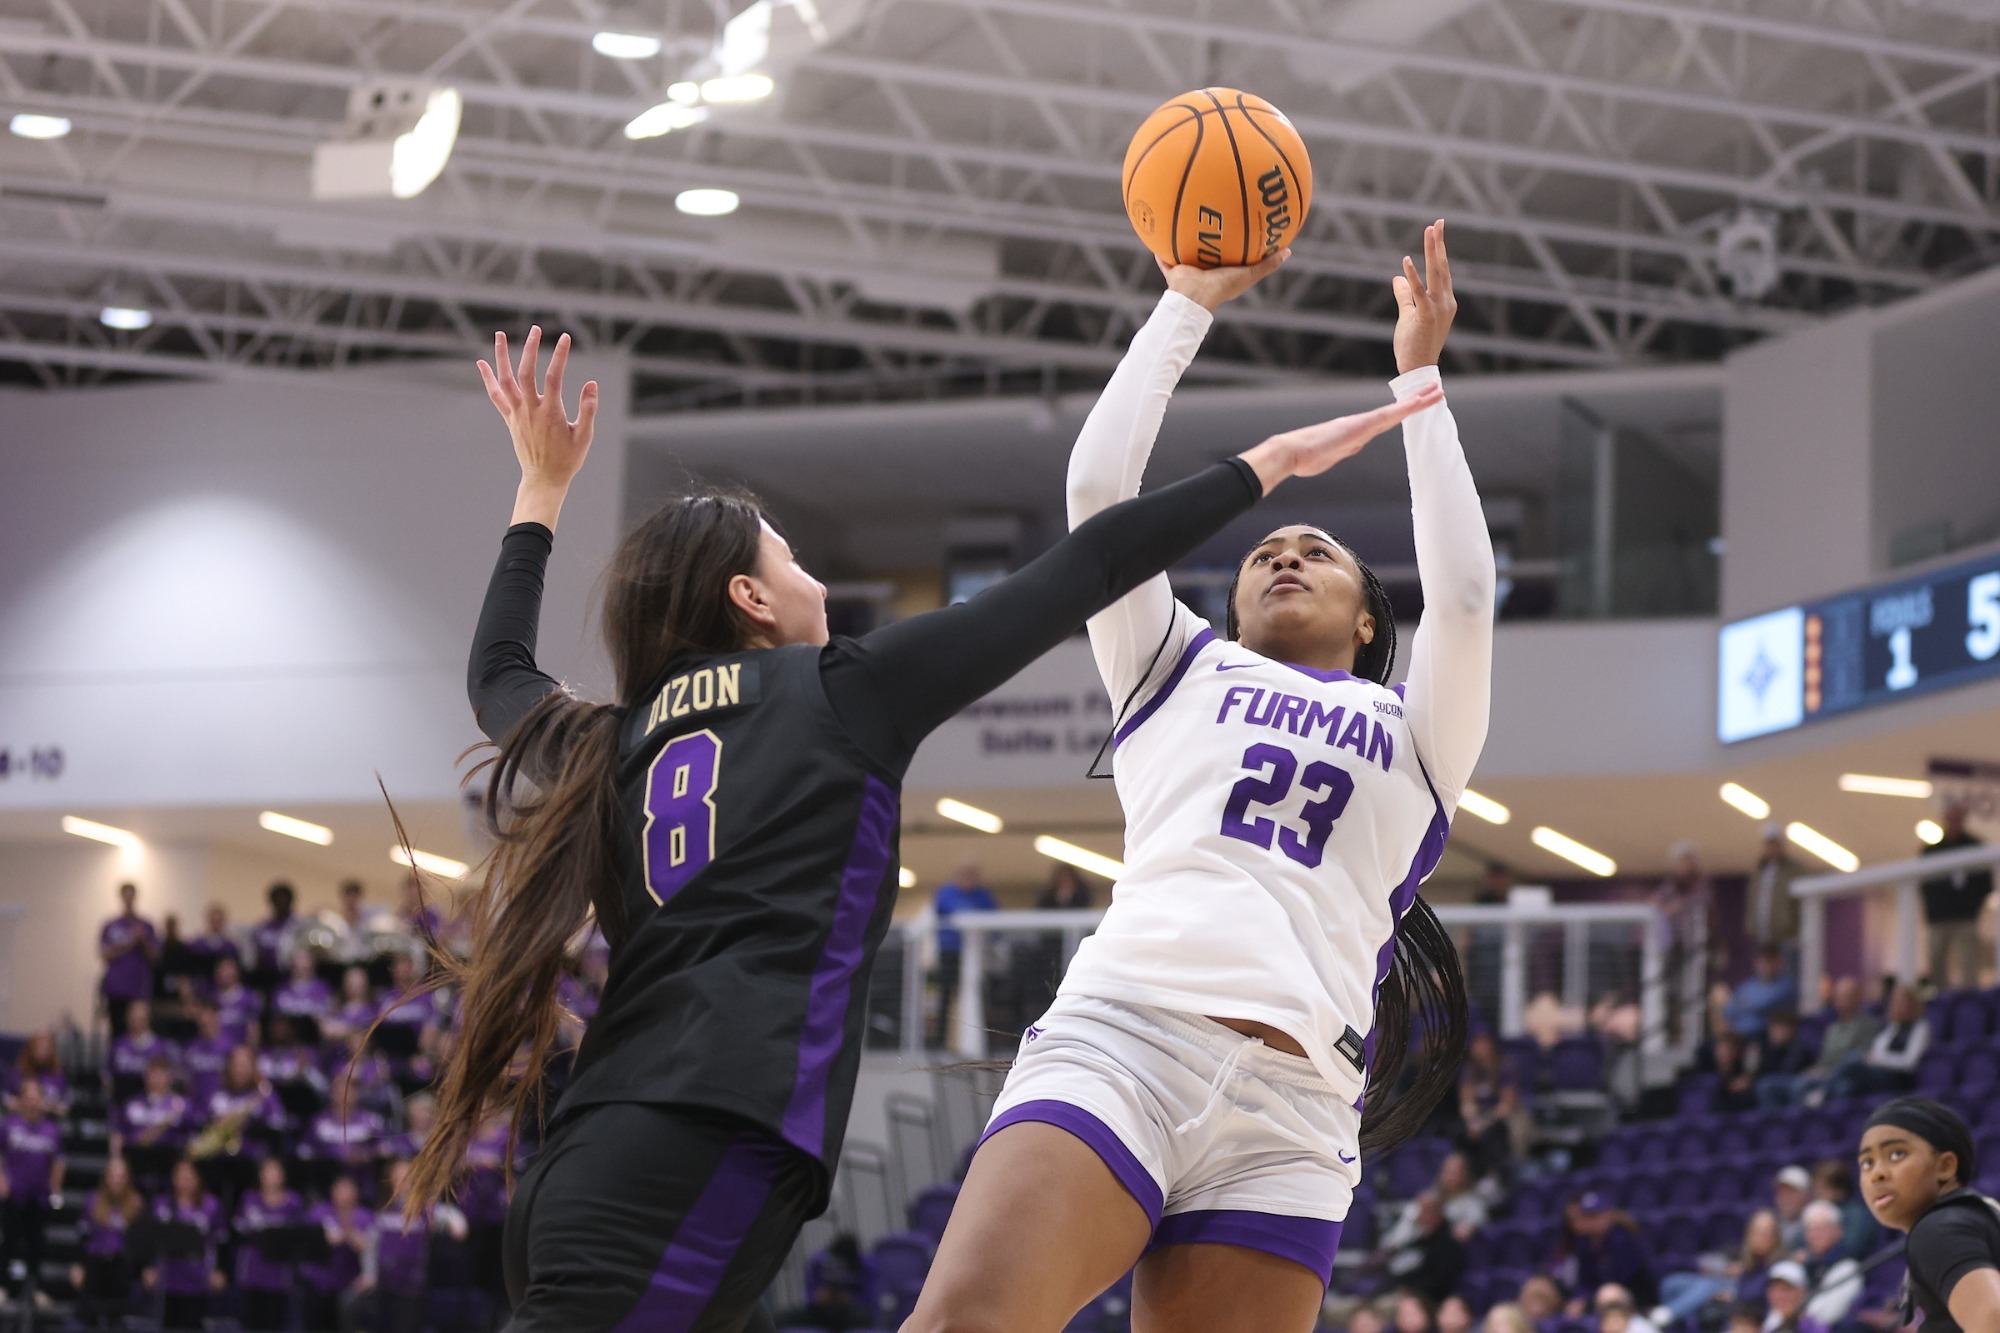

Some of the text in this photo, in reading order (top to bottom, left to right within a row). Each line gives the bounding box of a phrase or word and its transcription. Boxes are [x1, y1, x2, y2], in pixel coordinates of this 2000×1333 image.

[644, 663, 741, 736] DIZON
[1886, 627, 1918, 691] 1
[1216, 686, 1394, 773] FURMAN
[642, 728, 723, 907] 8
[1220, 742, 1355, 869] 23
